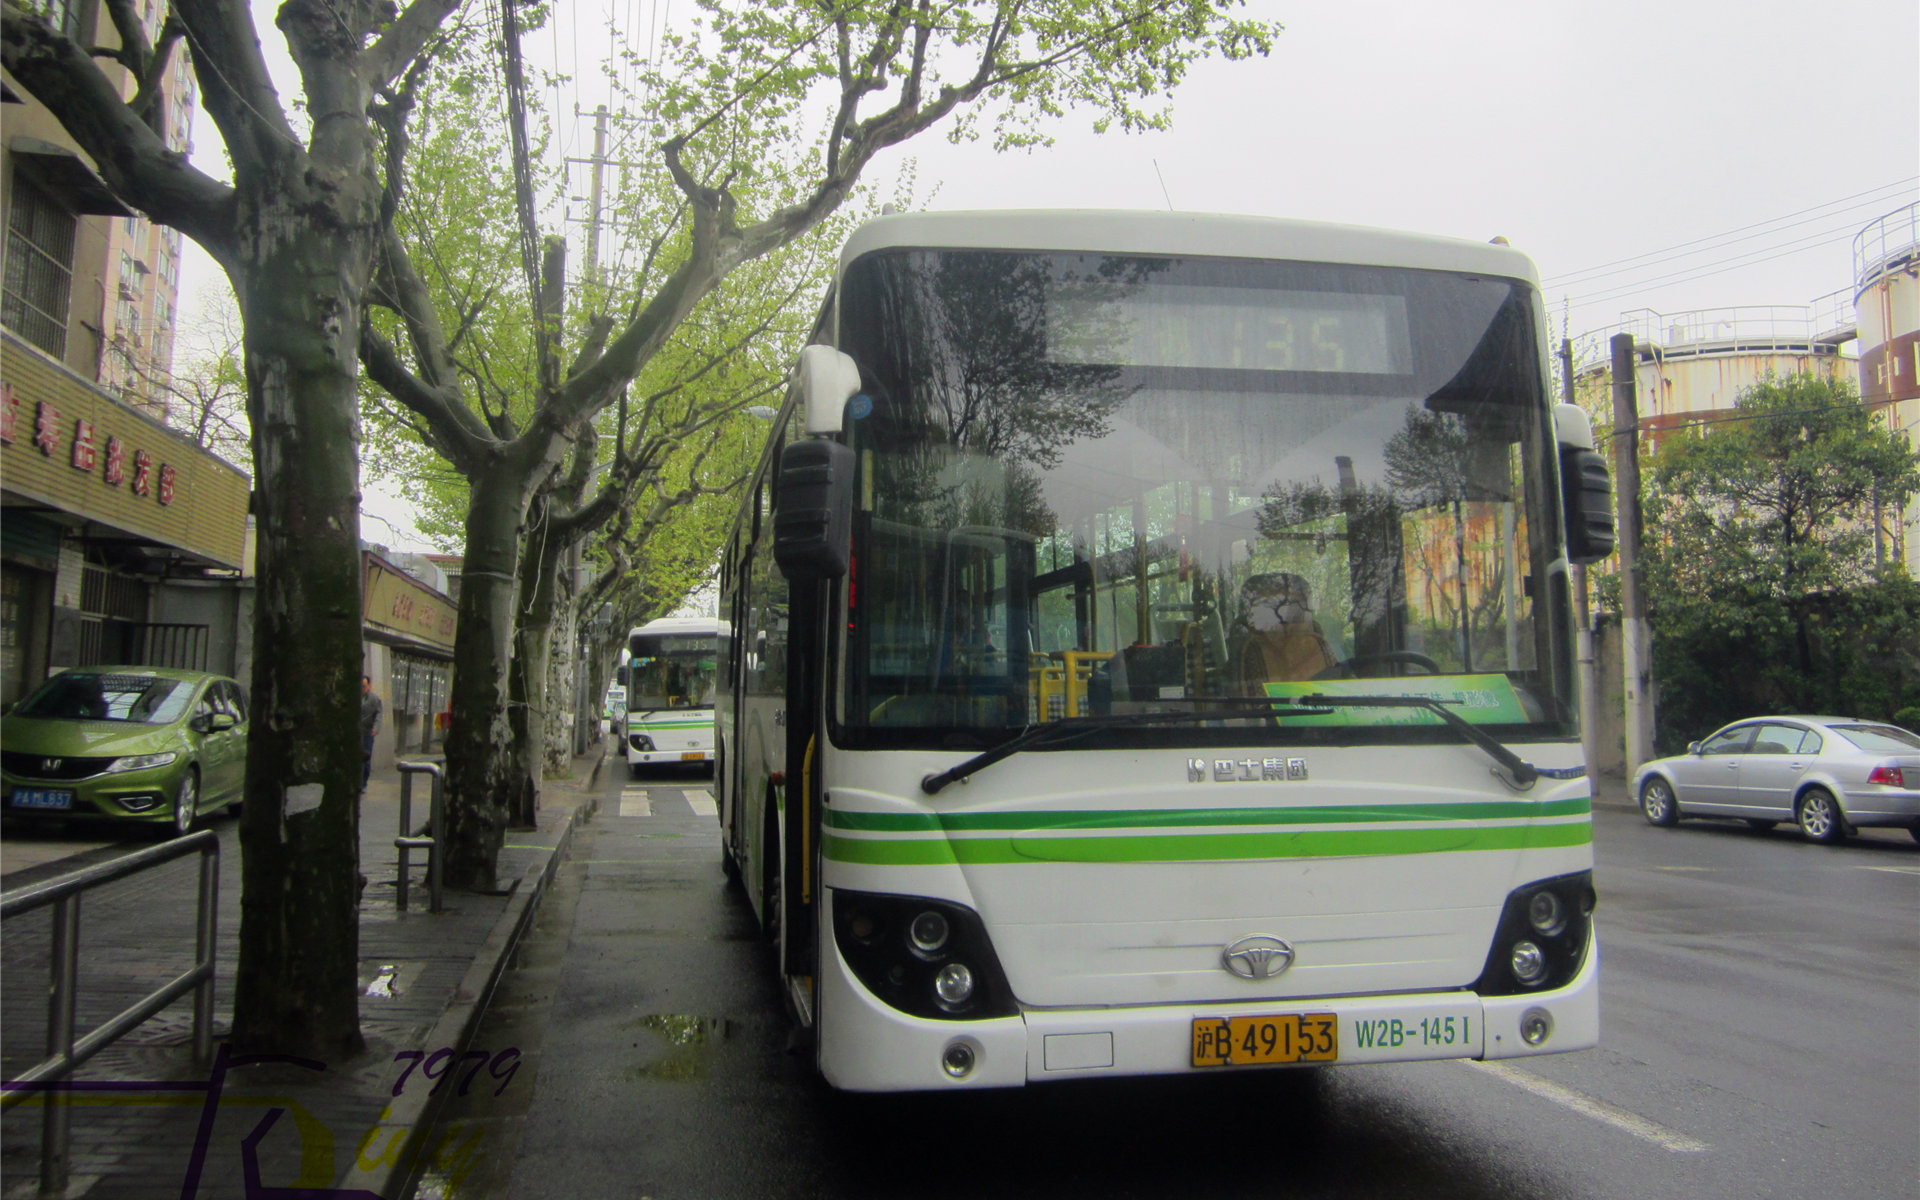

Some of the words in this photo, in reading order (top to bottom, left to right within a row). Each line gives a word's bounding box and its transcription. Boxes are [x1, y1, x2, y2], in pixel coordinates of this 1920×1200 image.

[1232, 316, 1344, 372] 135
[1214, 758, 1308, 782] 巴士集团
